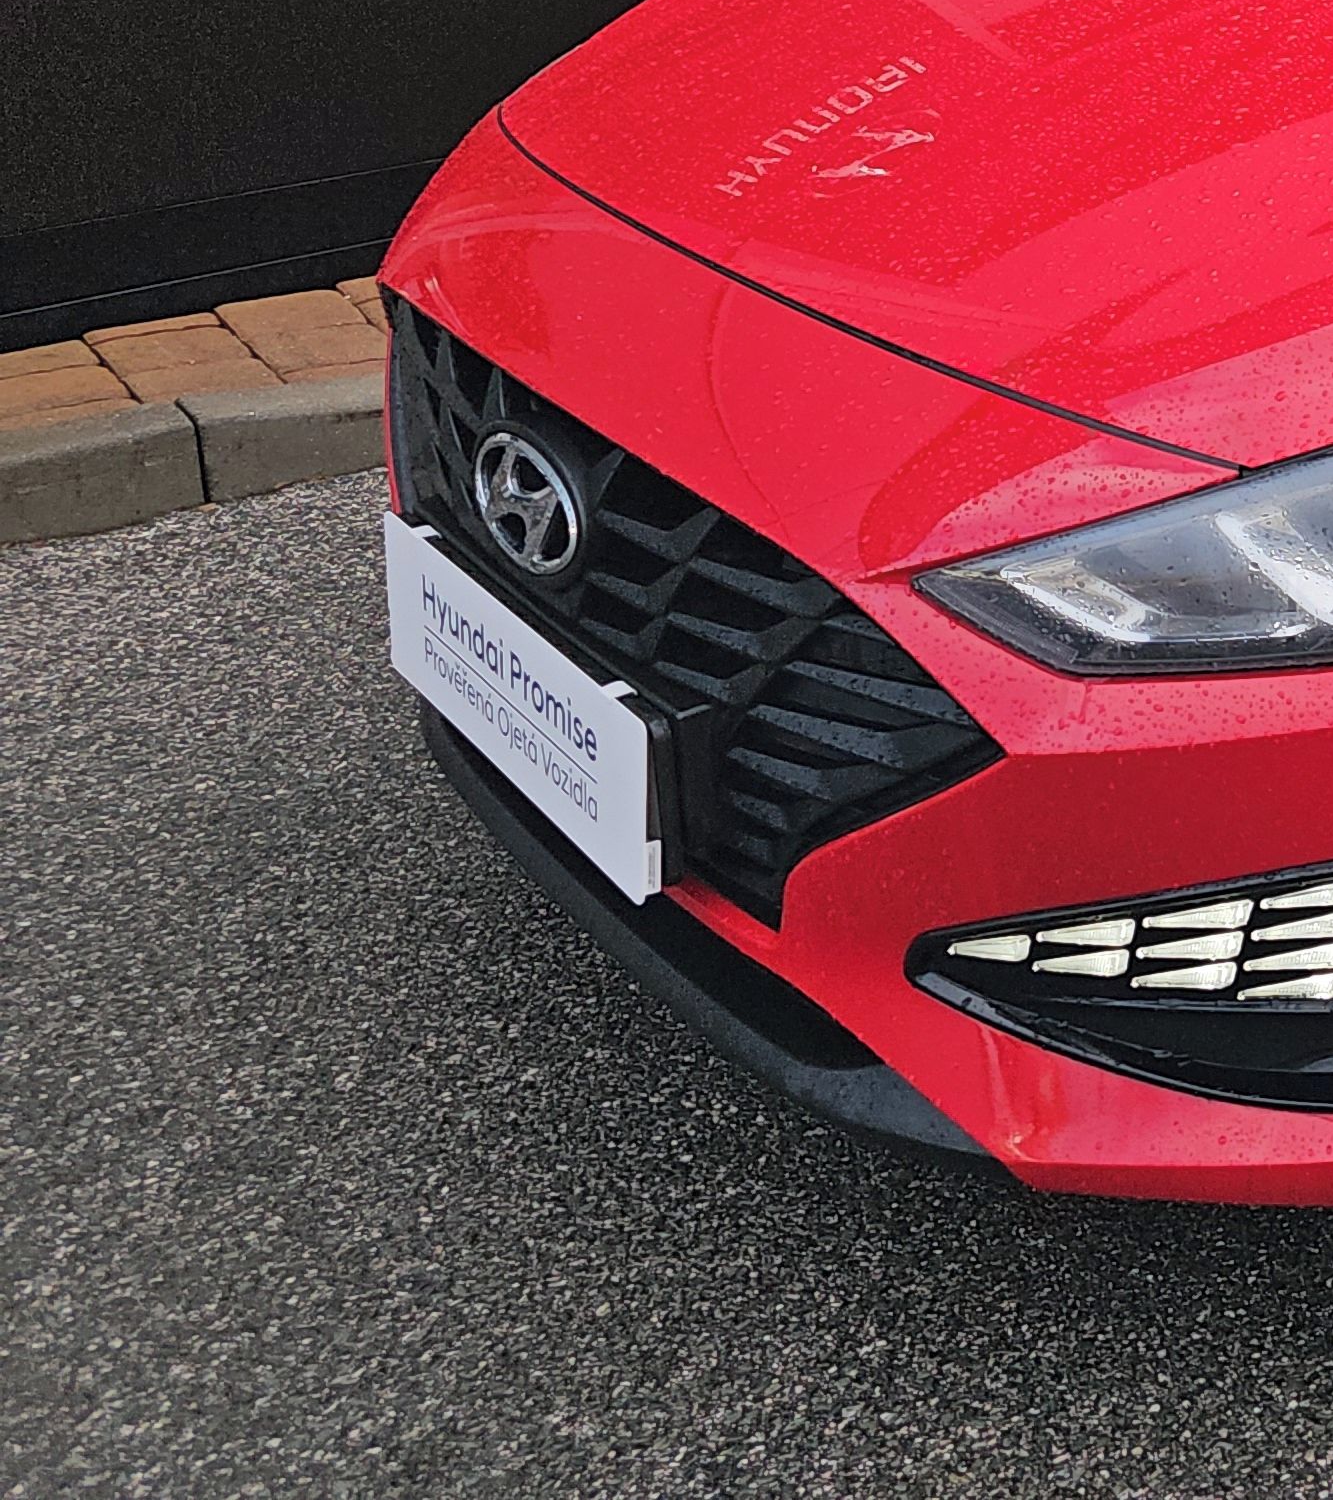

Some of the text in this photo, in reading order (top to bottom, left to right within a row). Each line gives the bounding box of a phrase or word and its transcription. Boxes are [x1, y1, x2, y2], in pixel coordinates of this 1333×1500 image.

[421, 573, 598, 762] Hyundai Promise
[424, 635, 598, 822] Prověřená Ojetá Vozidla
